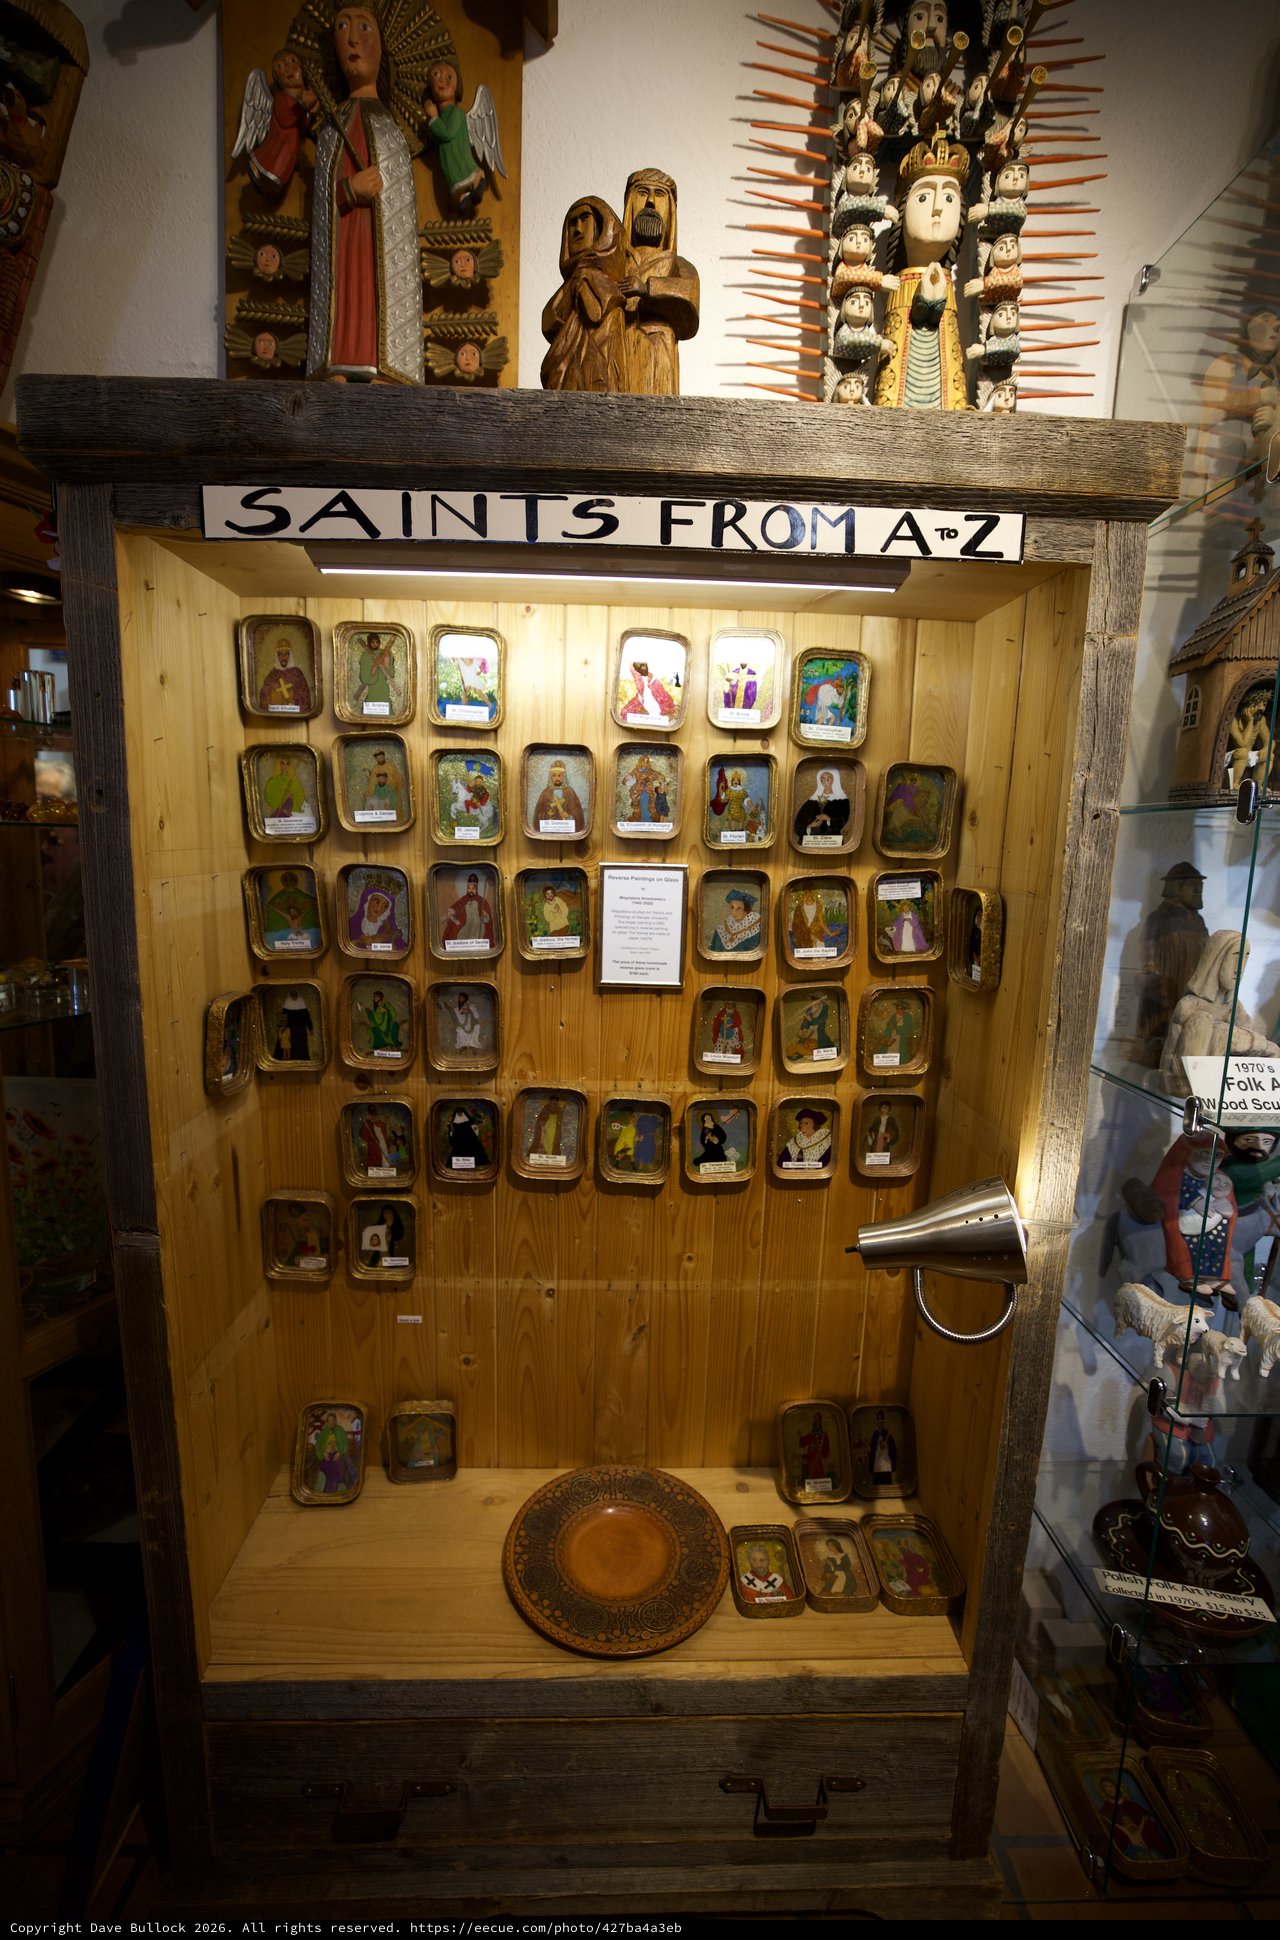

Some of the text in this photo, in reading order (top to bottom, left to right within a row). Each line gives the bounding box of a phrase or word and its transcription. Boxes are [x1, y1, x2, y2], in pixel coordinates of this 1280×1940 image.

[224, 487, 620, 542] SAINTS
[660, 500, 856, 553] FROM
[880, 511, 932, 556] A
[960, 514, 1005, 559] Z
[1234, 1063, 1275, 1074] 1970's
[1225, 1077, 1266, 1092] Folk
[1201, 1098, 1248, 1110] Wood
[1102, 1570, 1144, 1585] Polish
[1181, 1585, 1204, 1595] Art
[1204, 1589, 1255, 1606] Pottery
[1104, 1585, 1153, 1599] Collected
[1155, 1592, 1166, 1601] in
[1169, 1595, 1202, 1607] 1970s
[1230, 1606, 1242, 1615] to
